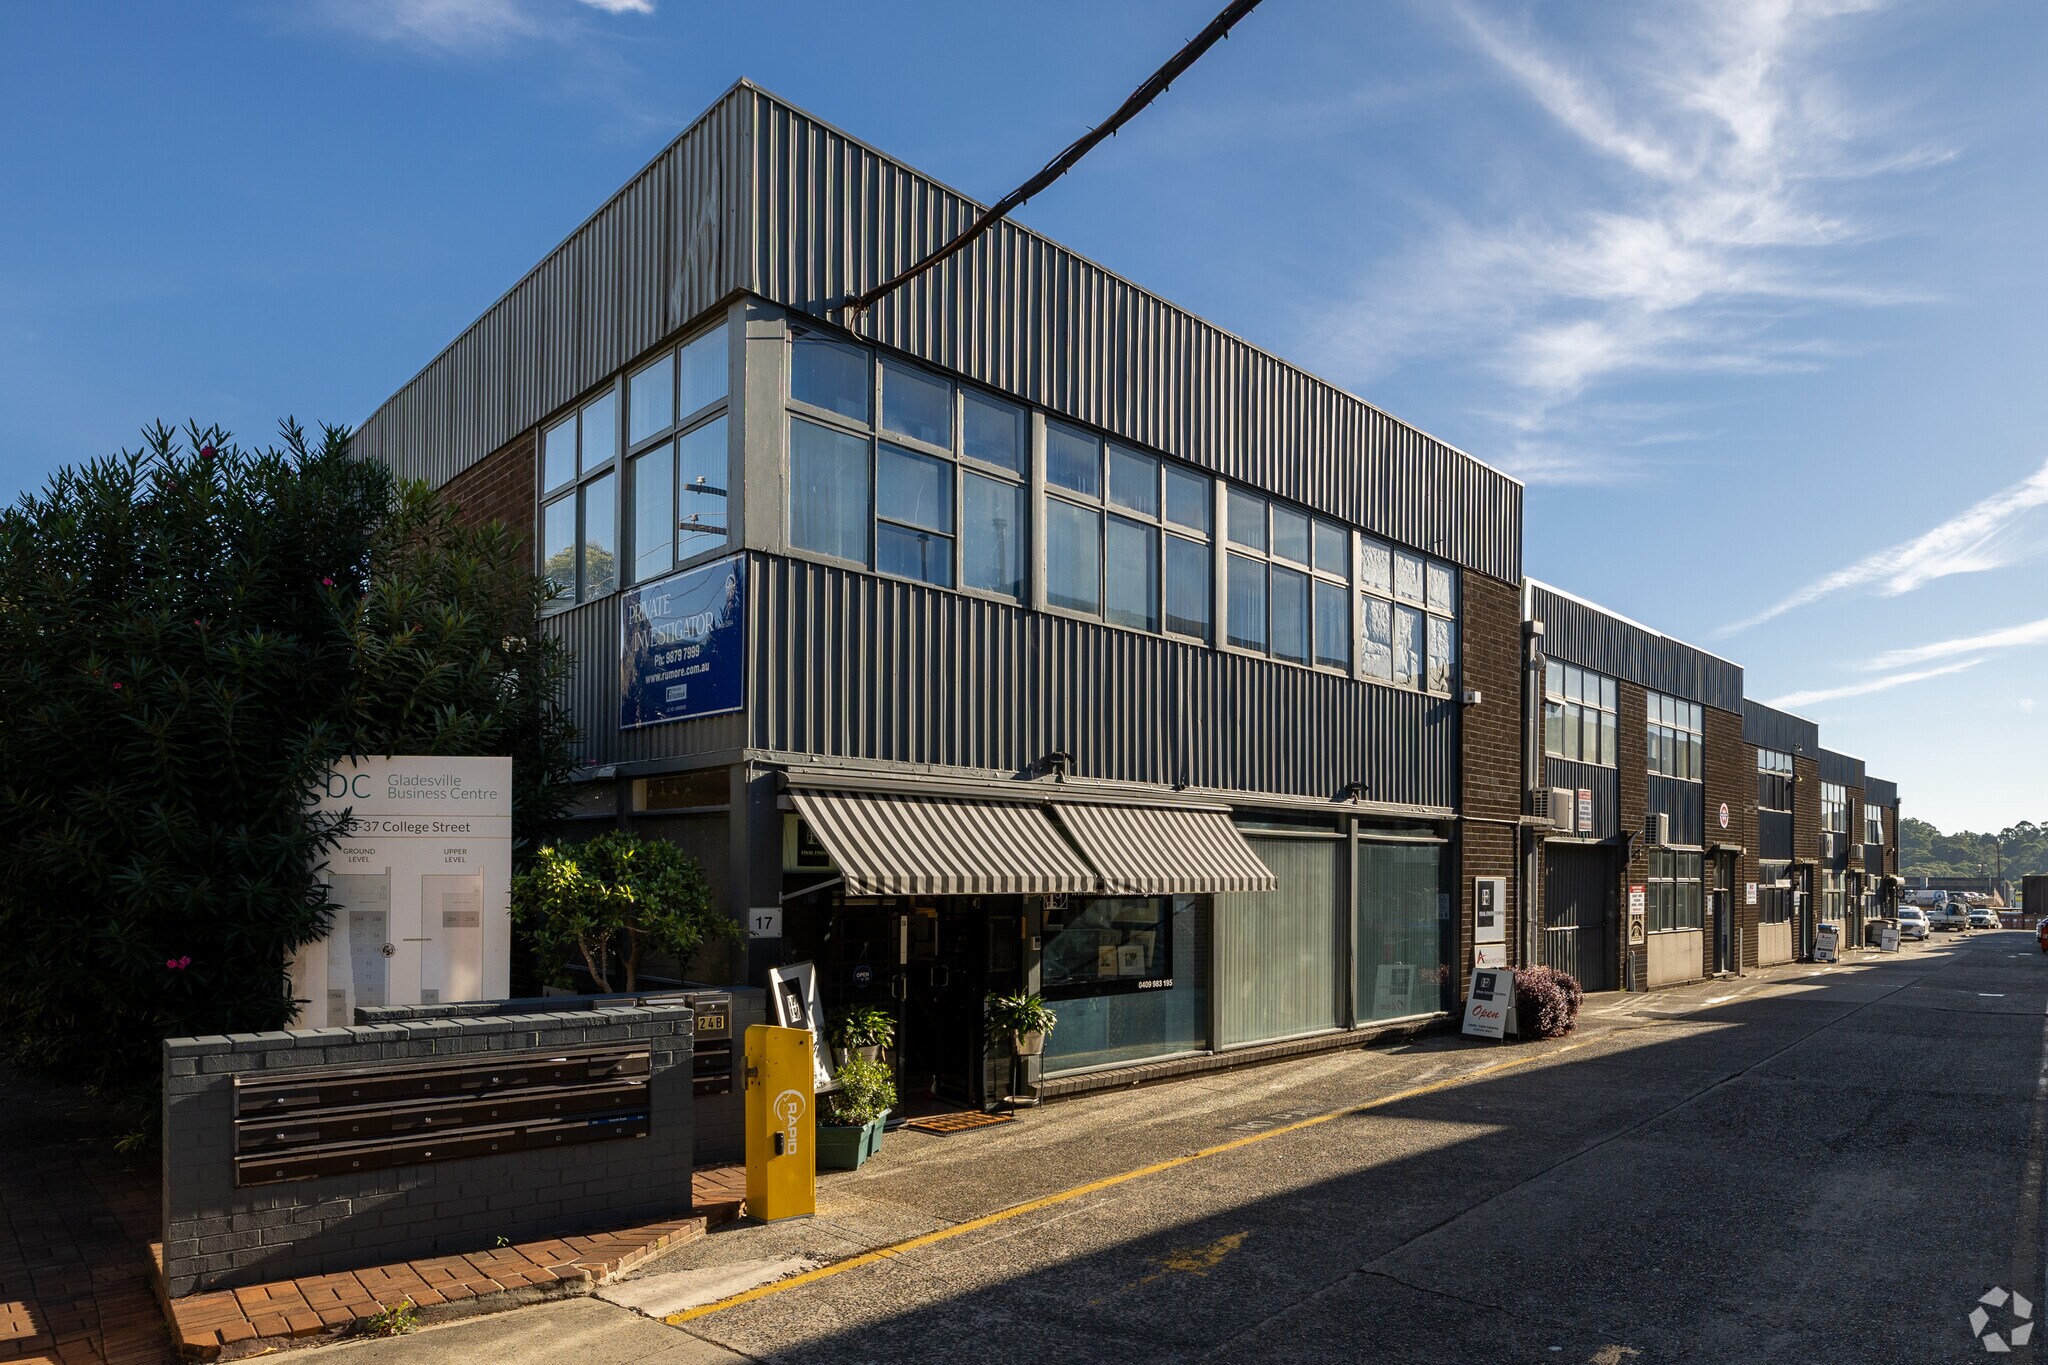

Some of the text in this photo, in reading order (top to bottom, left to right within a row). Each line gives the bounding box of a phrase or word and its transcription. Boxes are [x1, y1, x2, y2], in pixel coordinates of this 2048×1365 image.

[629, 593, 672, 625] PRIVATE
[634, 611, 715, 652] INVESTIGATOR
[666, 648, 682, 664] 9879
[683, 644, 700, 661] 7999
[645, 662, 710, 684] www.rumore.com.au
[387, 773, 462, 787] Gladesville
[387, 786, 498, 800] Business Centre
[382, 821, 429, 834] College
[432, 820, 471, 832] Street
[755, 916, 773, 930] 17
[1138, 980, 1152, 989] 0409
[1163, 978, 1173, 987] 195
[1472, 1004, 1500, 1020] Open
[699, 1017, 723, 1030] 24B
[787, 1102, 797, 1155] RAPID
